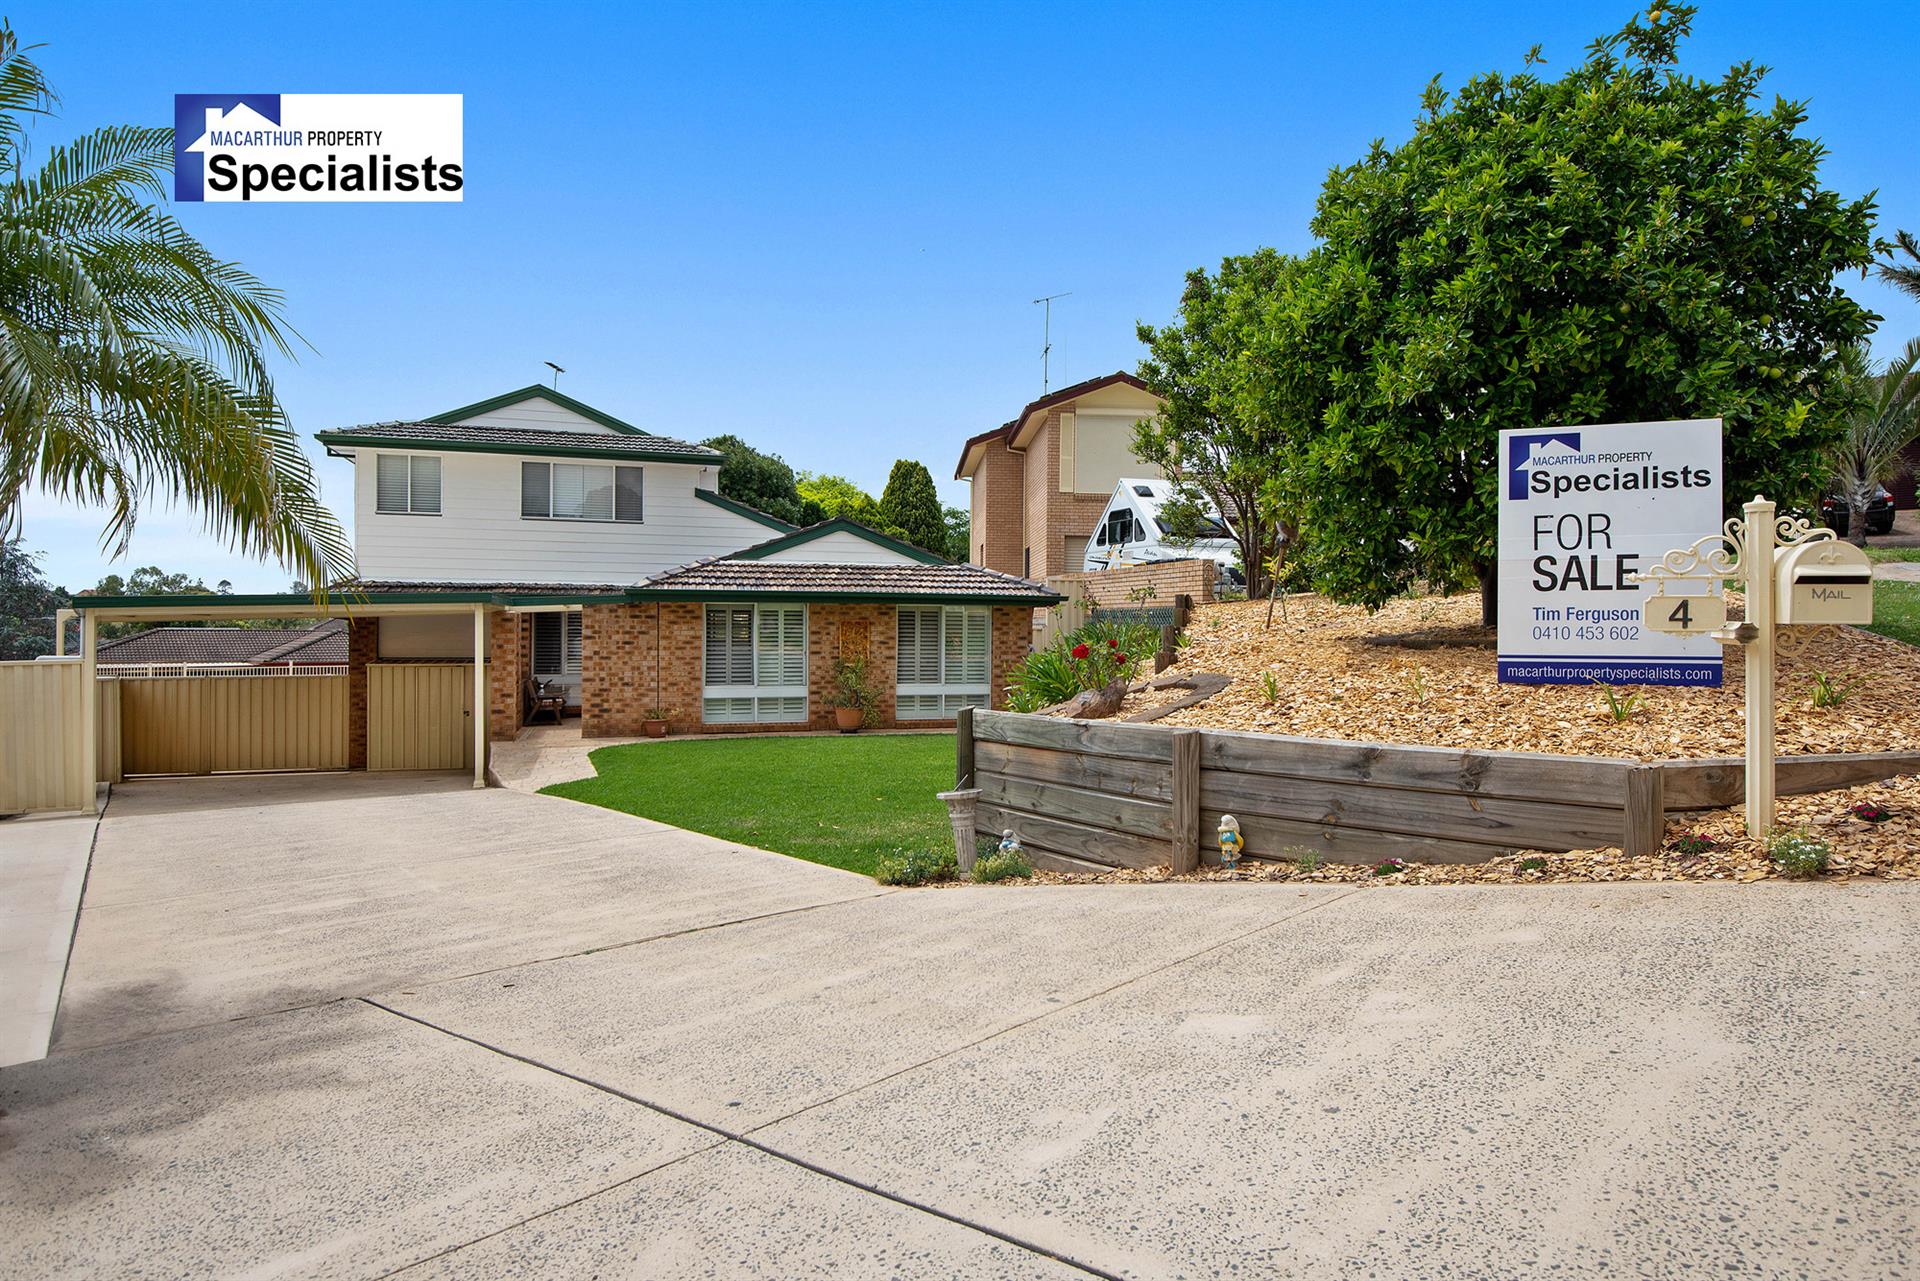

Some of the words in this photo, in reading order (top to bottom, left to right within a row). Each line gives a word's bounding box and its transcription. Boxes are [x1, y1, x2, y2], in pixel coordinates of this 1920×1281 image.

[1532, 454, 1596, 466] MACARTHUR
[1598, 451, 1653, 464] PROPERTY
[1530, 464, 1712, 499] Specialists
[1533, 513, 1612, 551] FOR
[1532, 554, 1640, 592] SALE
[1811, 588, 1852, 602] MAIL
[1532, 607, 1561, 621] Tim
[1566, 607, 1640, 624] Ferguson
[1668, 599, 1693, 630] 4
[1532, 626, 1571, 641] 0410
[1575, 626, 1605, 641] 453
[1609, 626, 1640, 641] 602
[1507, 666, 1713, 681] macarthurpropertyspecialists.com
